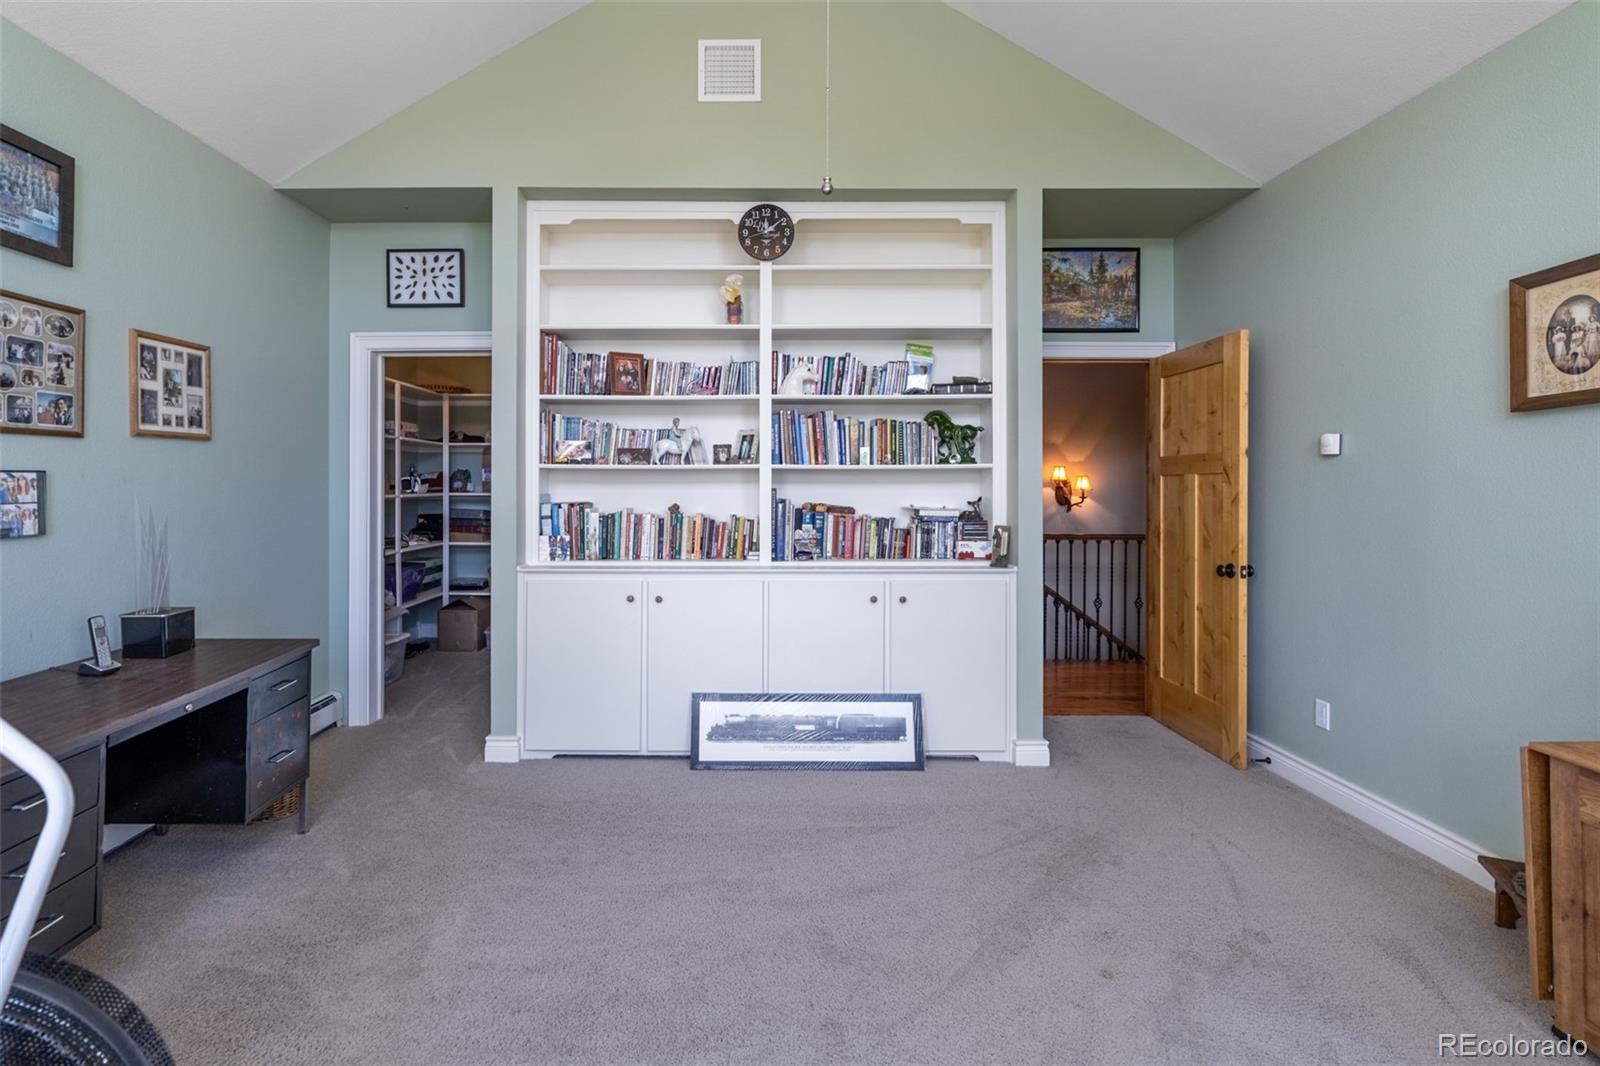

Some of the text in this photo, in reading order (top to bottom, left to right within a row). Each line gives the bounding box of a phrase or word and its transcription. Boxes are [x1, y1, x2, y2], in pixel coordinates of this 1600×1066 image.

[762, 208, 771, 216] 12
[745, 218, 753, 226] 10
[742, 229, 748, 237] 9
[784, 228, 790, 236] 3
[745, 238, 751, 246] 8
[782, 237, 787, 245] 4
[763, 248, 769, 256] 6
[775, 245, 780, 253] 5
